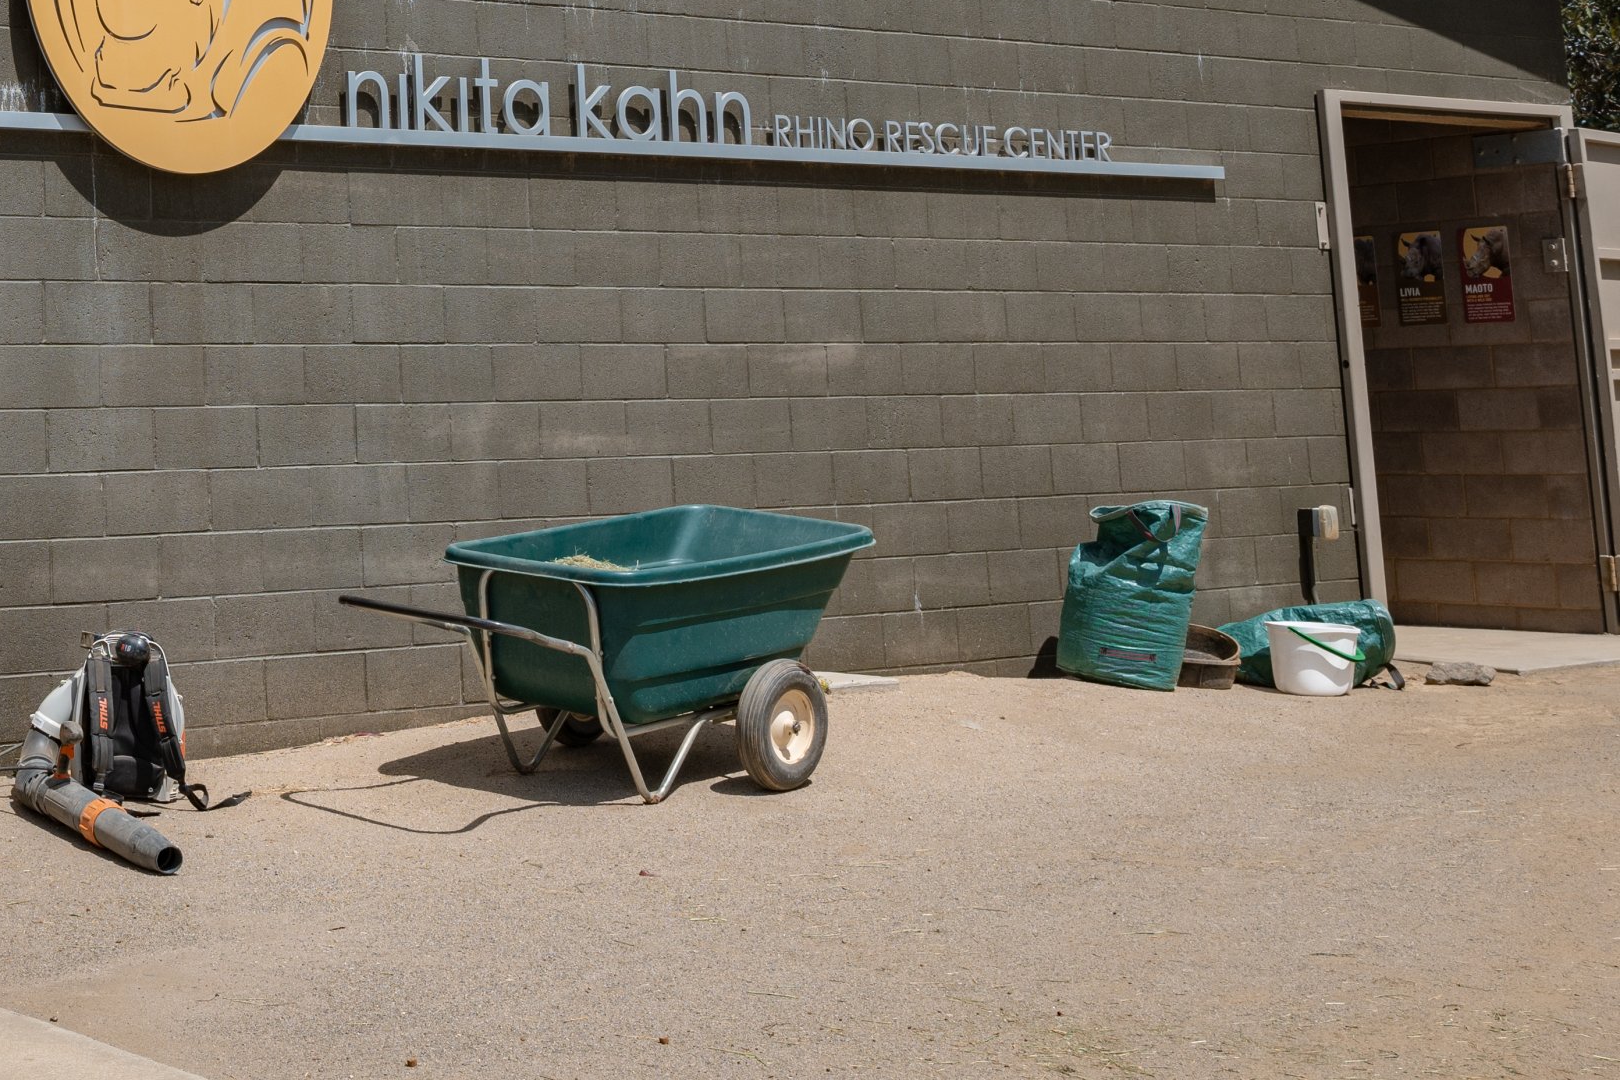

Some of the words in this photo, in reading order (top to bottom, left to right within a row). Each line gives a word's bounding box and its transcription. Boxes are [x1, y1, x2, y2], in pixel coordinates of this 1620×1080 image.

[346, 53, 551, 137] nikita
[576, 63, 753, 146] kahn
[774, 114, 875, 151] RHINO
[884, 120, 997, 157] RESCUE
[1004, 126, 1113, 162] CENTER
[1400, 288, 1421, 297] LIVIA
[1465, 283, 1493, 294] MAOTO
[99, 697, 108, 730] STIHL
[153, 702, 167, 733] STIHL
